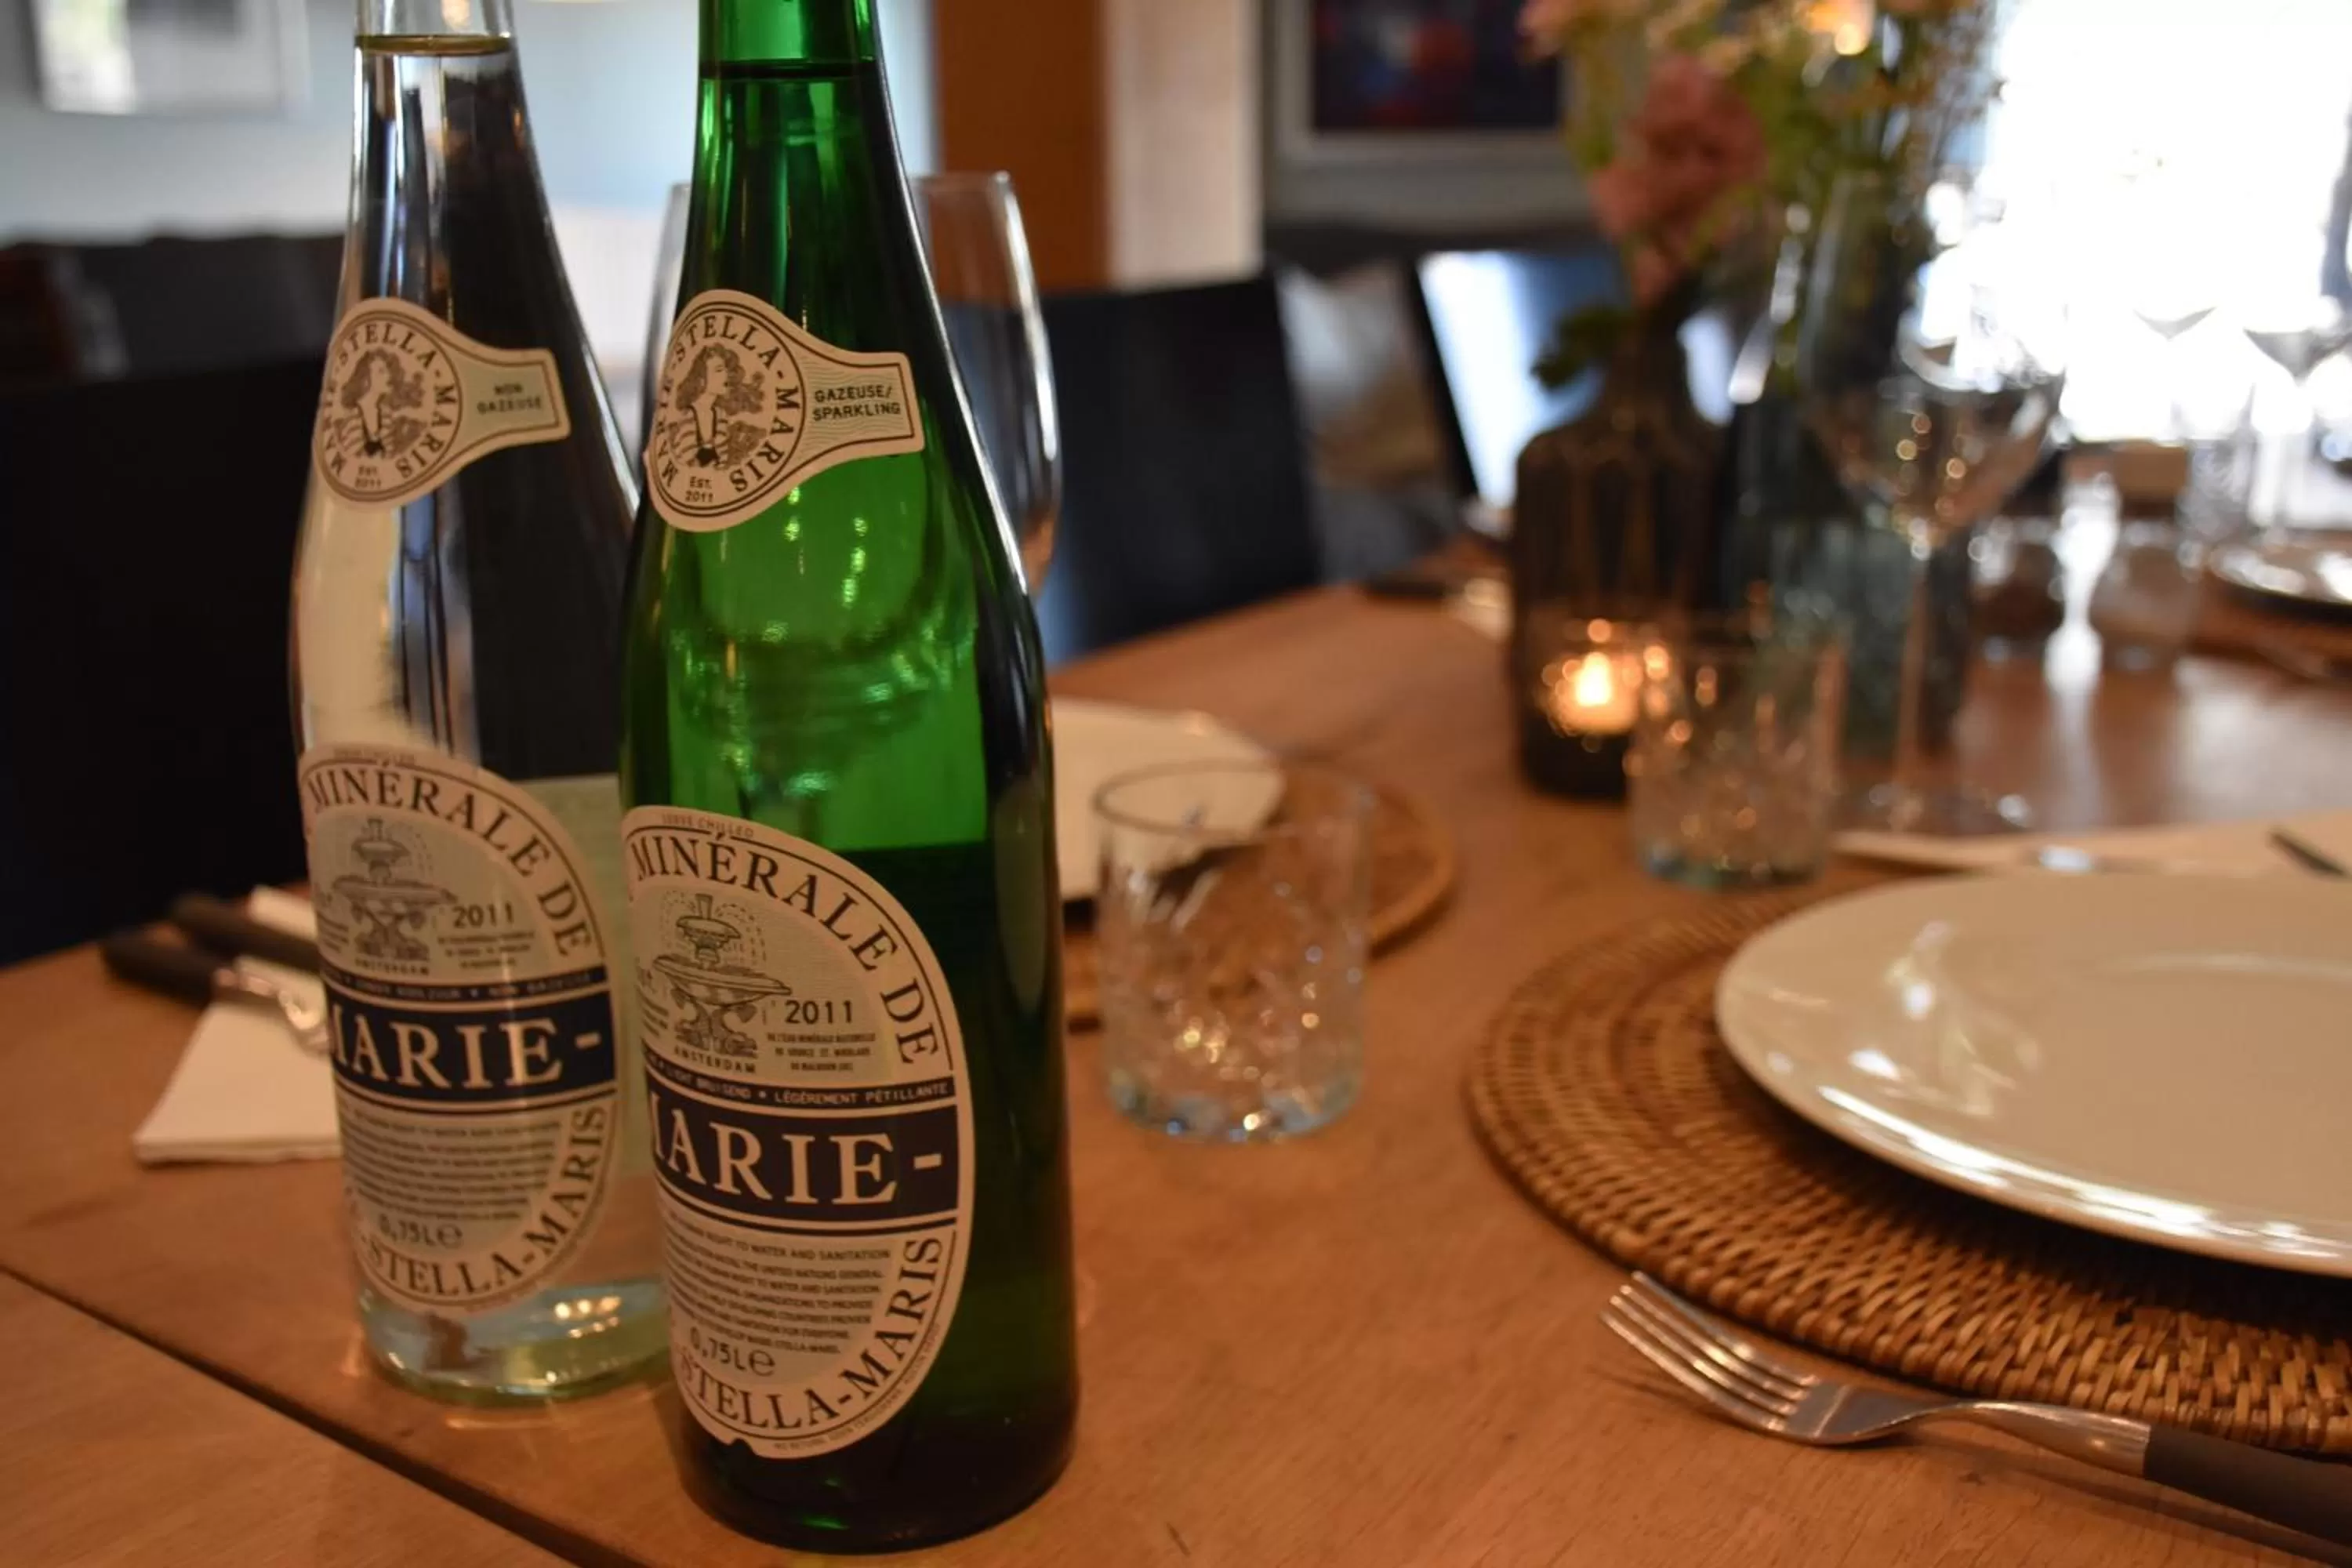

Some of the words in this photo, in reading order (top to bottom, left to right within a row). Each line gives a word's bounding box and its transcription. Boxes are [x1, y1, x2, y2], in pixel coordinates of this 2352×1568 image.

[813, 403, 901, 422] SPARKLING
[684, 489, 714, 503] 2011
[452, 901, 515, 928] 2011
[537, 880, 592, 956] DE
[630, 832, 900, 971] MINÉRALE
[880, 978, 941, 1065] DE
[785, 1000, 853, 1025] 2011
[673, 1045, 757, 1073] AMSTERDAM
